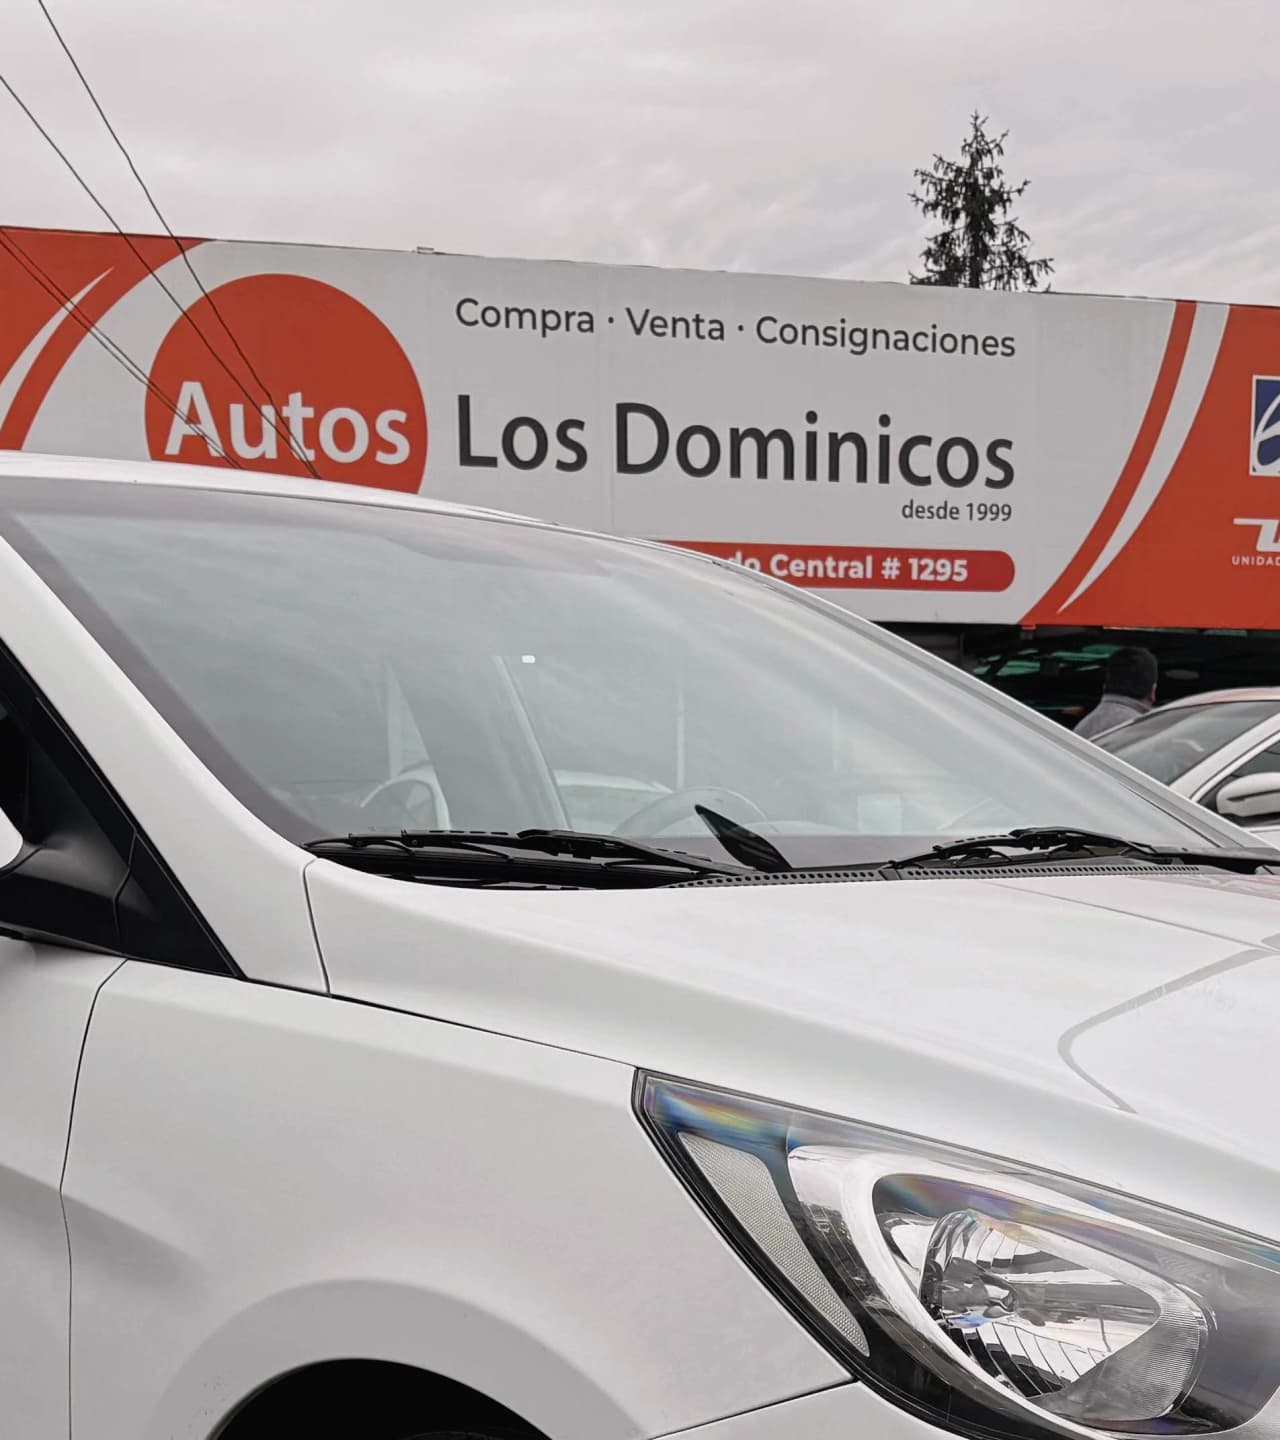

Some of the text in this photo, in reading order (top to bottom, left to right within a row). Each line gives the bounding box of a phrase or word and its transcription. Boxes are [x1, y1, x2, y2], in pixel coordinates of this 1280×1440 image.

[455, 297, 1017, 358] Compra Venta Consignaciones
[163, 379, 412, 466] Autos
[457, 393, 1016, 490] Los Dominicos
[901, 498, 1012, 523] desde 1999
[769, 553, 873, 580] Central
[881, 557, 901, 580] #
[908, 556, 969, 582] 1295
